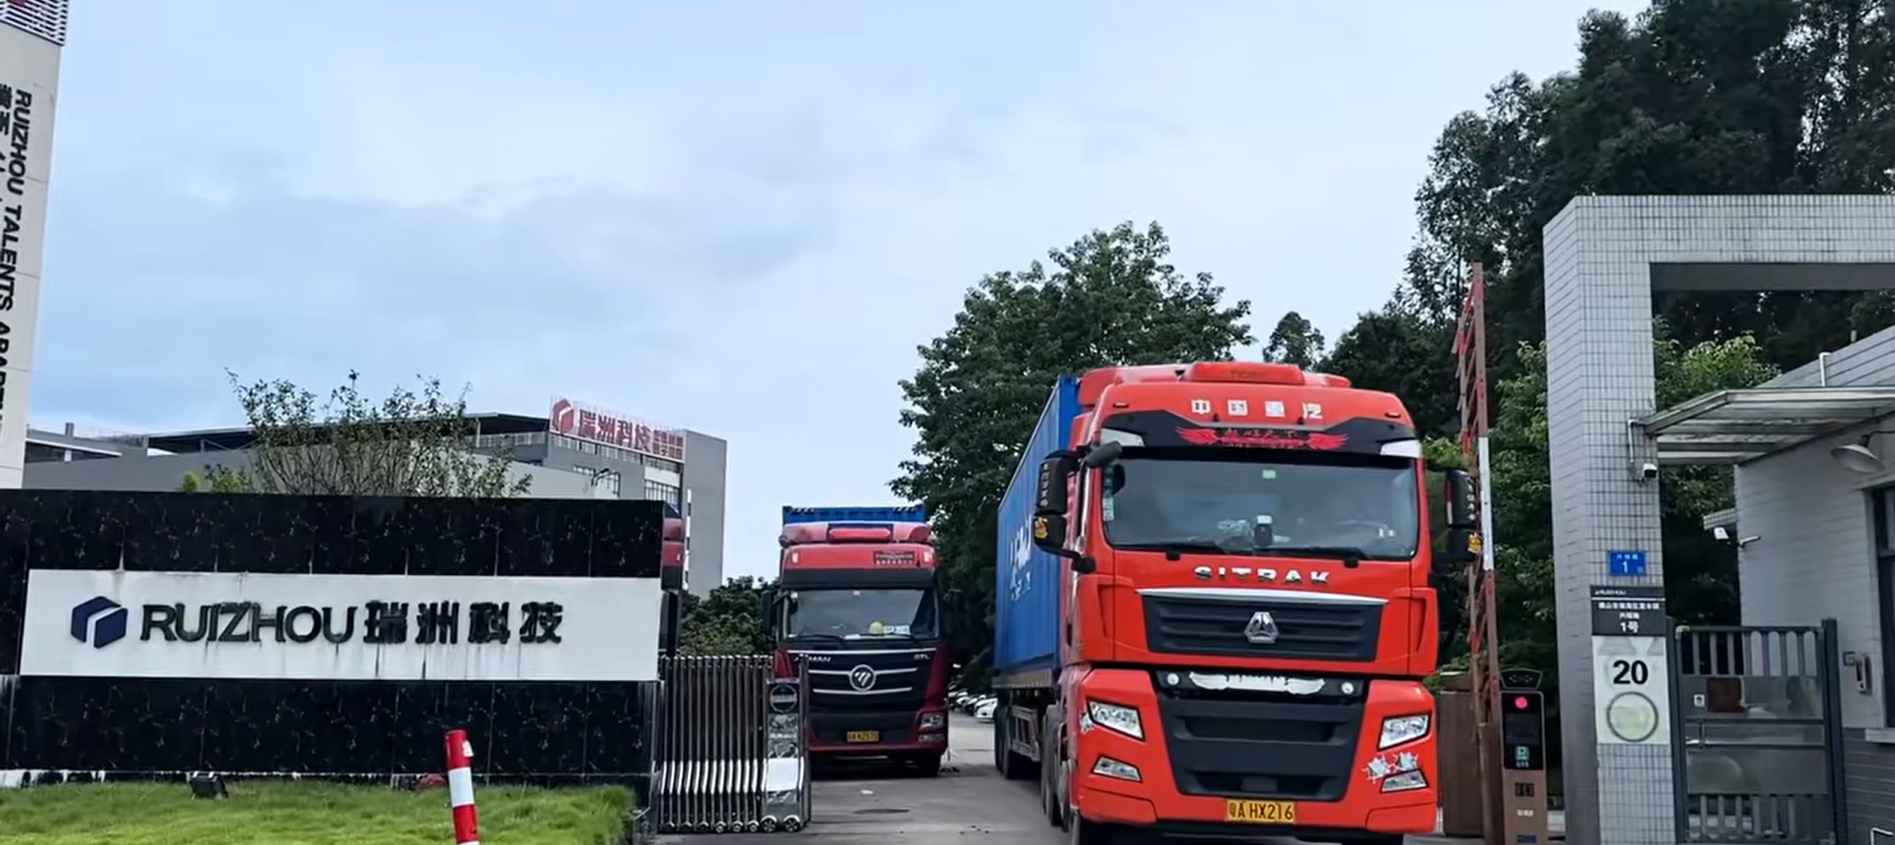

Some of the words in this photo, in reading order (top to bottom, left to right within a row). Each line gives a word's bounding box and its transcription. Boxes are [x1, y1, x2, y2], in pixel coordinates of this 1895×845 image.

[7, 88, 33, 196] RUIZHOU
[0, 205, 22, 311] TALENTS
[1194, 566, 1330, 584] SITRAK
[140, 603, 358, 643] RUIZHOU
[362, 600, 562, 645] 瑞洲科技
[1620, 621, 1639, 633] 1号
[1613, 659, 1648, 685] 20
